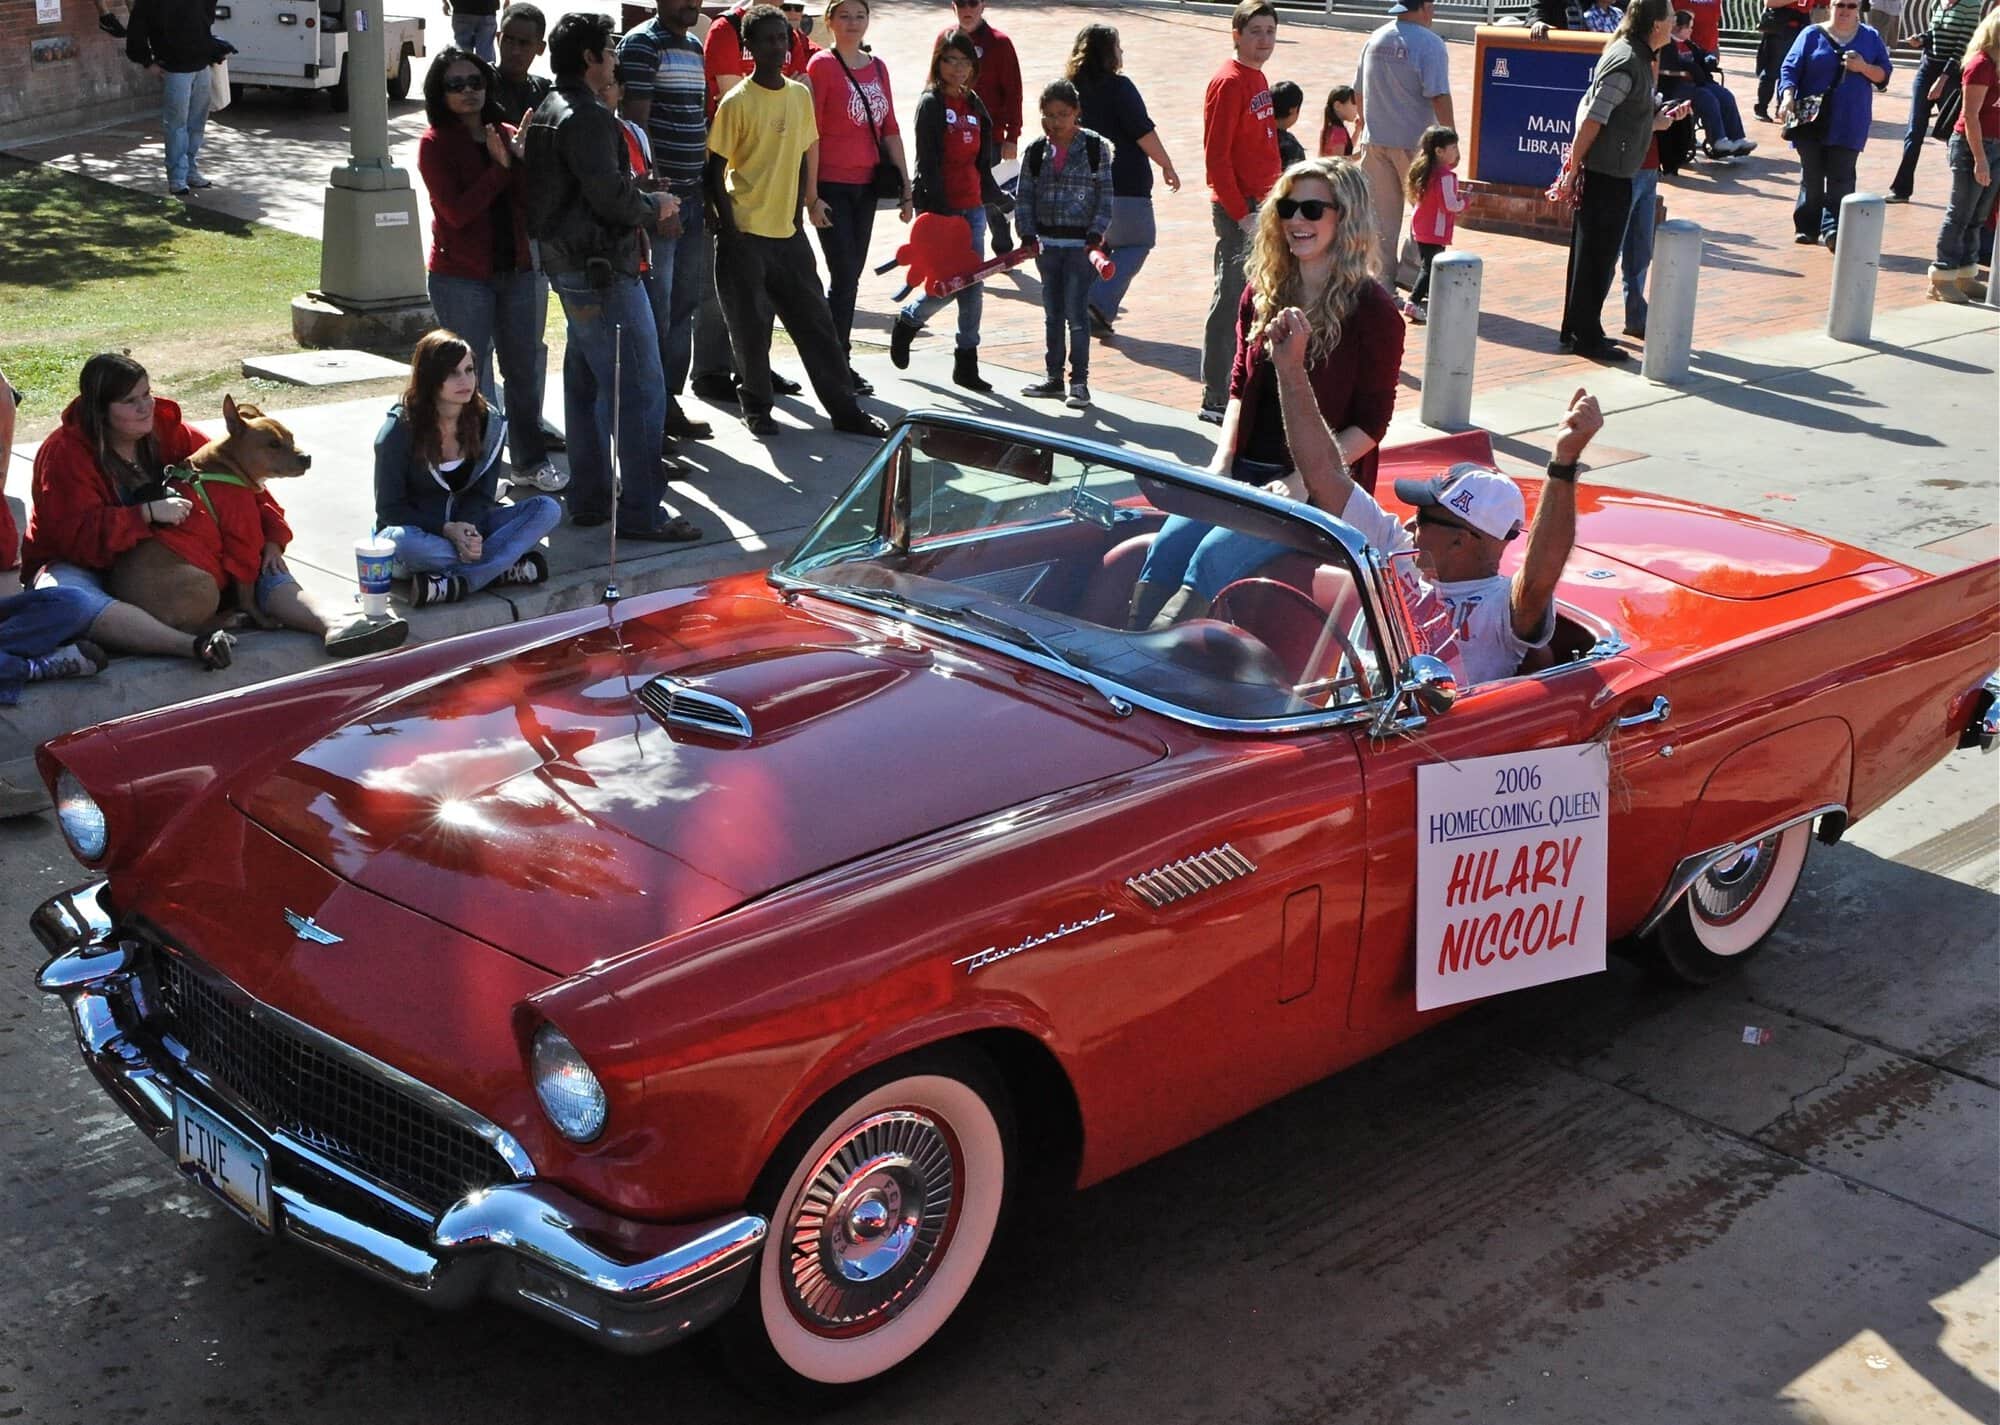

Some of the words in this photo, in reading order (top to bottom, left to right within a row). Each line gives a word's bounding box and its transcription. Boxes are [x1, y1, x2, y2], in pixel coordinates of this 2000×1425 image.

[1527, 115, 1571, 134] MAIN
[1451, 489, 1474, 513] A
[1495, 765, 1542, 795] 2006
[1430, 800, 1543, 845] HOMECOMING
[1549, 791, 1601, 828] QUEEN
[1446, 836, 1583, 907] HILARY
[951, 909, 1116, 976] Thunderbird
[1437, 895, 1585, 976] NICCOLI
[184, 1115, 231, 1184] FIVE
[251, 1162, 261, 1207] 7
